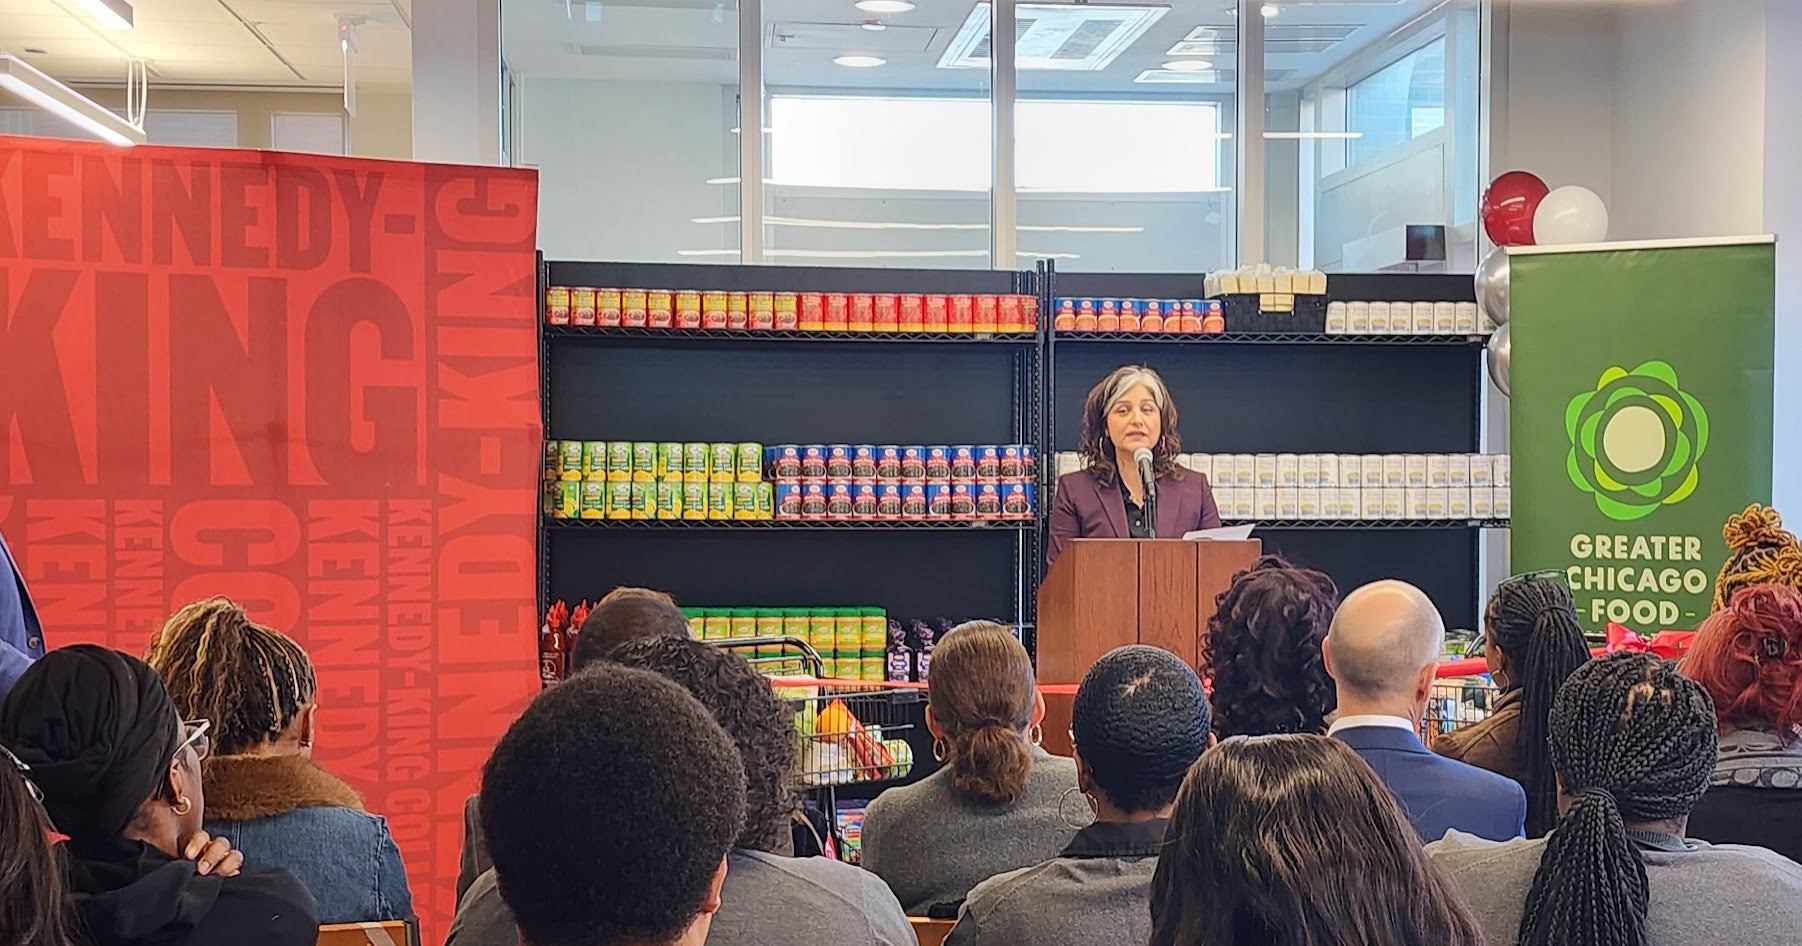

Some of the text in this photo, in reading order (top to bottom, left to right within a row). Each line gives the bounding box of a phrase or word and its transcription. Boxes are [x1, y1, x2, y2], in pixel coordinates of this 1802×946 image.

[0, 269, 416, 487] KING
[1570, 534, 1702, 561] GREATER
[1568, 566, 1707, 594] CHICAGO
[1591, 599, 1679, 625] FOOD
[387, 499, 432, 780] KENNEDY-KING
